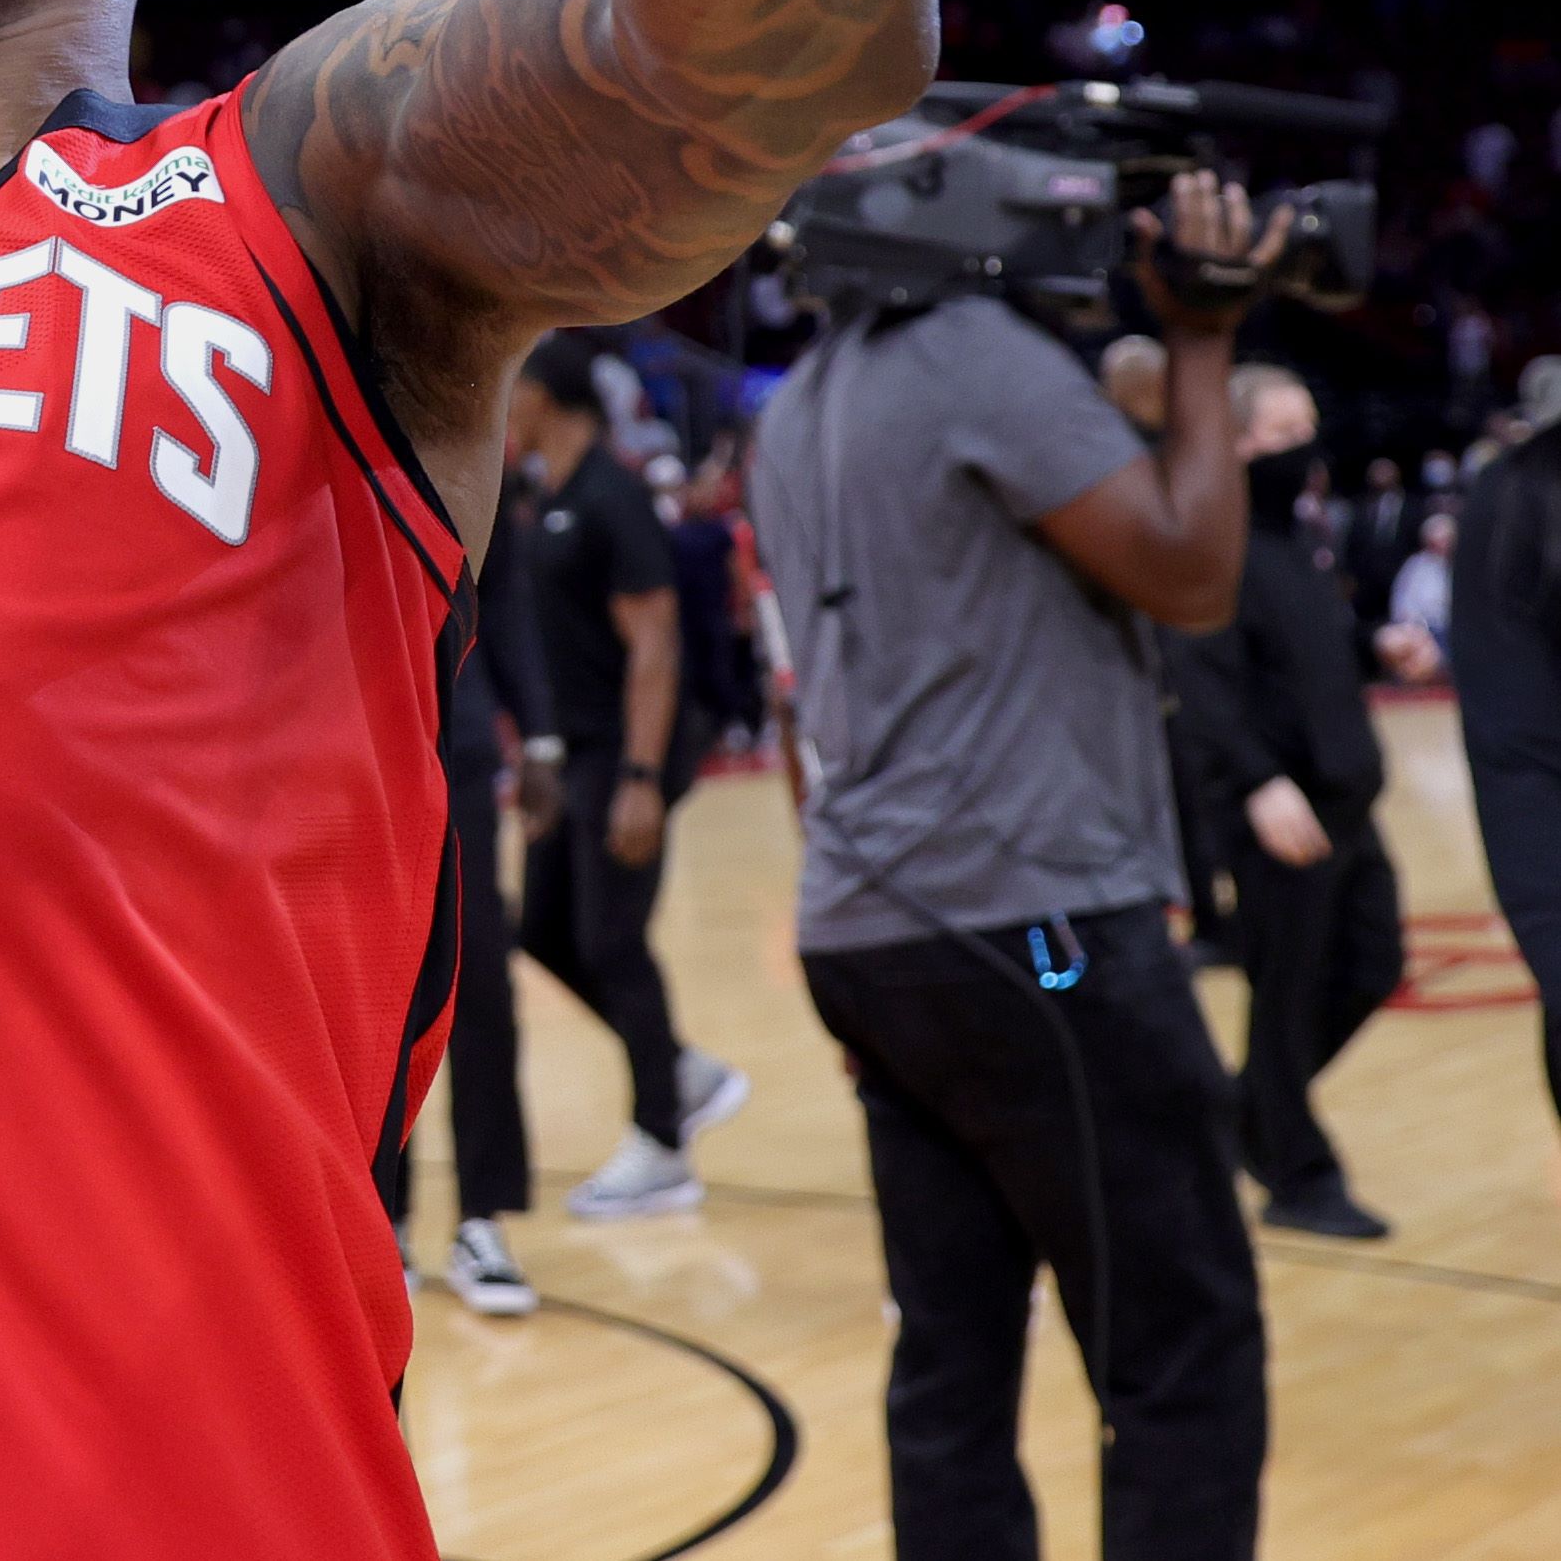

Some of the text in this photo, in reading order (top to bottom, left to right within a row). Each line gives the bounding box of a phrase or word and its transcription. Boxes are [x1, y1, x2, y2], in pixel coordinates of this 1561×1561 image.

[38, 170, 210, 222] MONEY
[41, 154, 210, 205] credit karma
